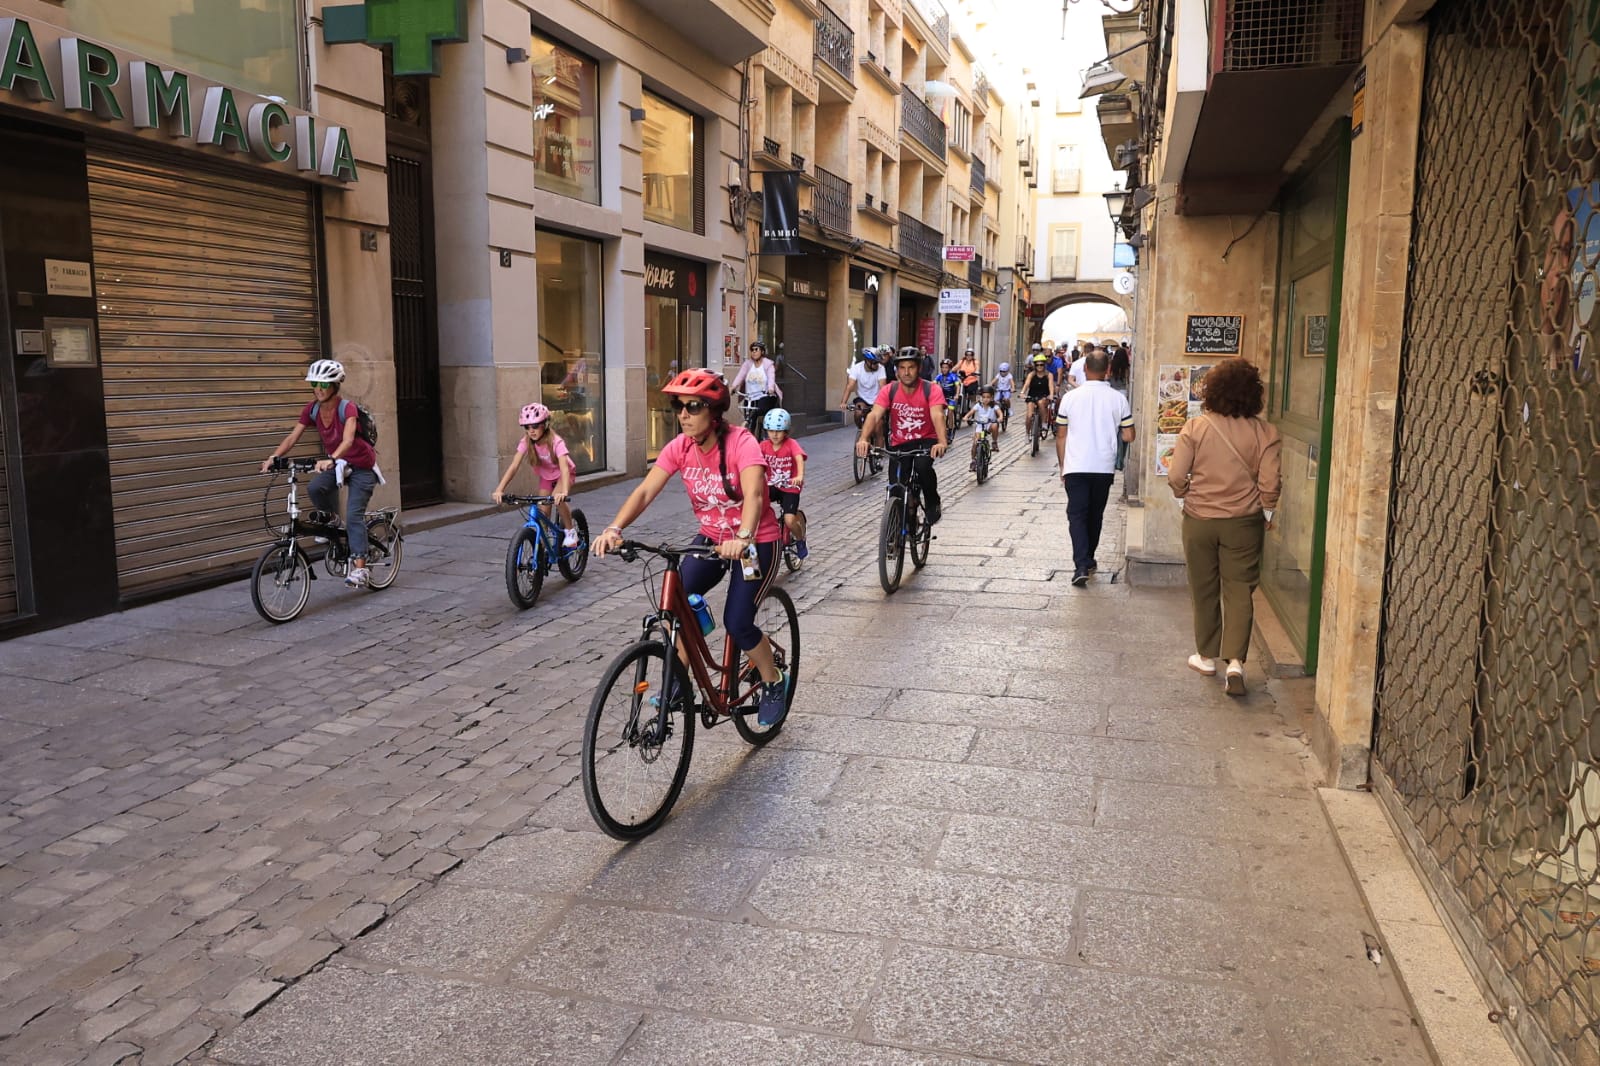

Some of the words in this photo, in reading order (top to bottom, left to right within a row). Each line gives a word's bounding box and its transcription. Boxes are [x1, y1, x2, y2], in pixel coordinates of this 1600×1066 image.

[0, 17, 358, 182] ARMACIA
[764, 227, 798, 237] BAMBÚ
[683, 467, 702, 481] III
